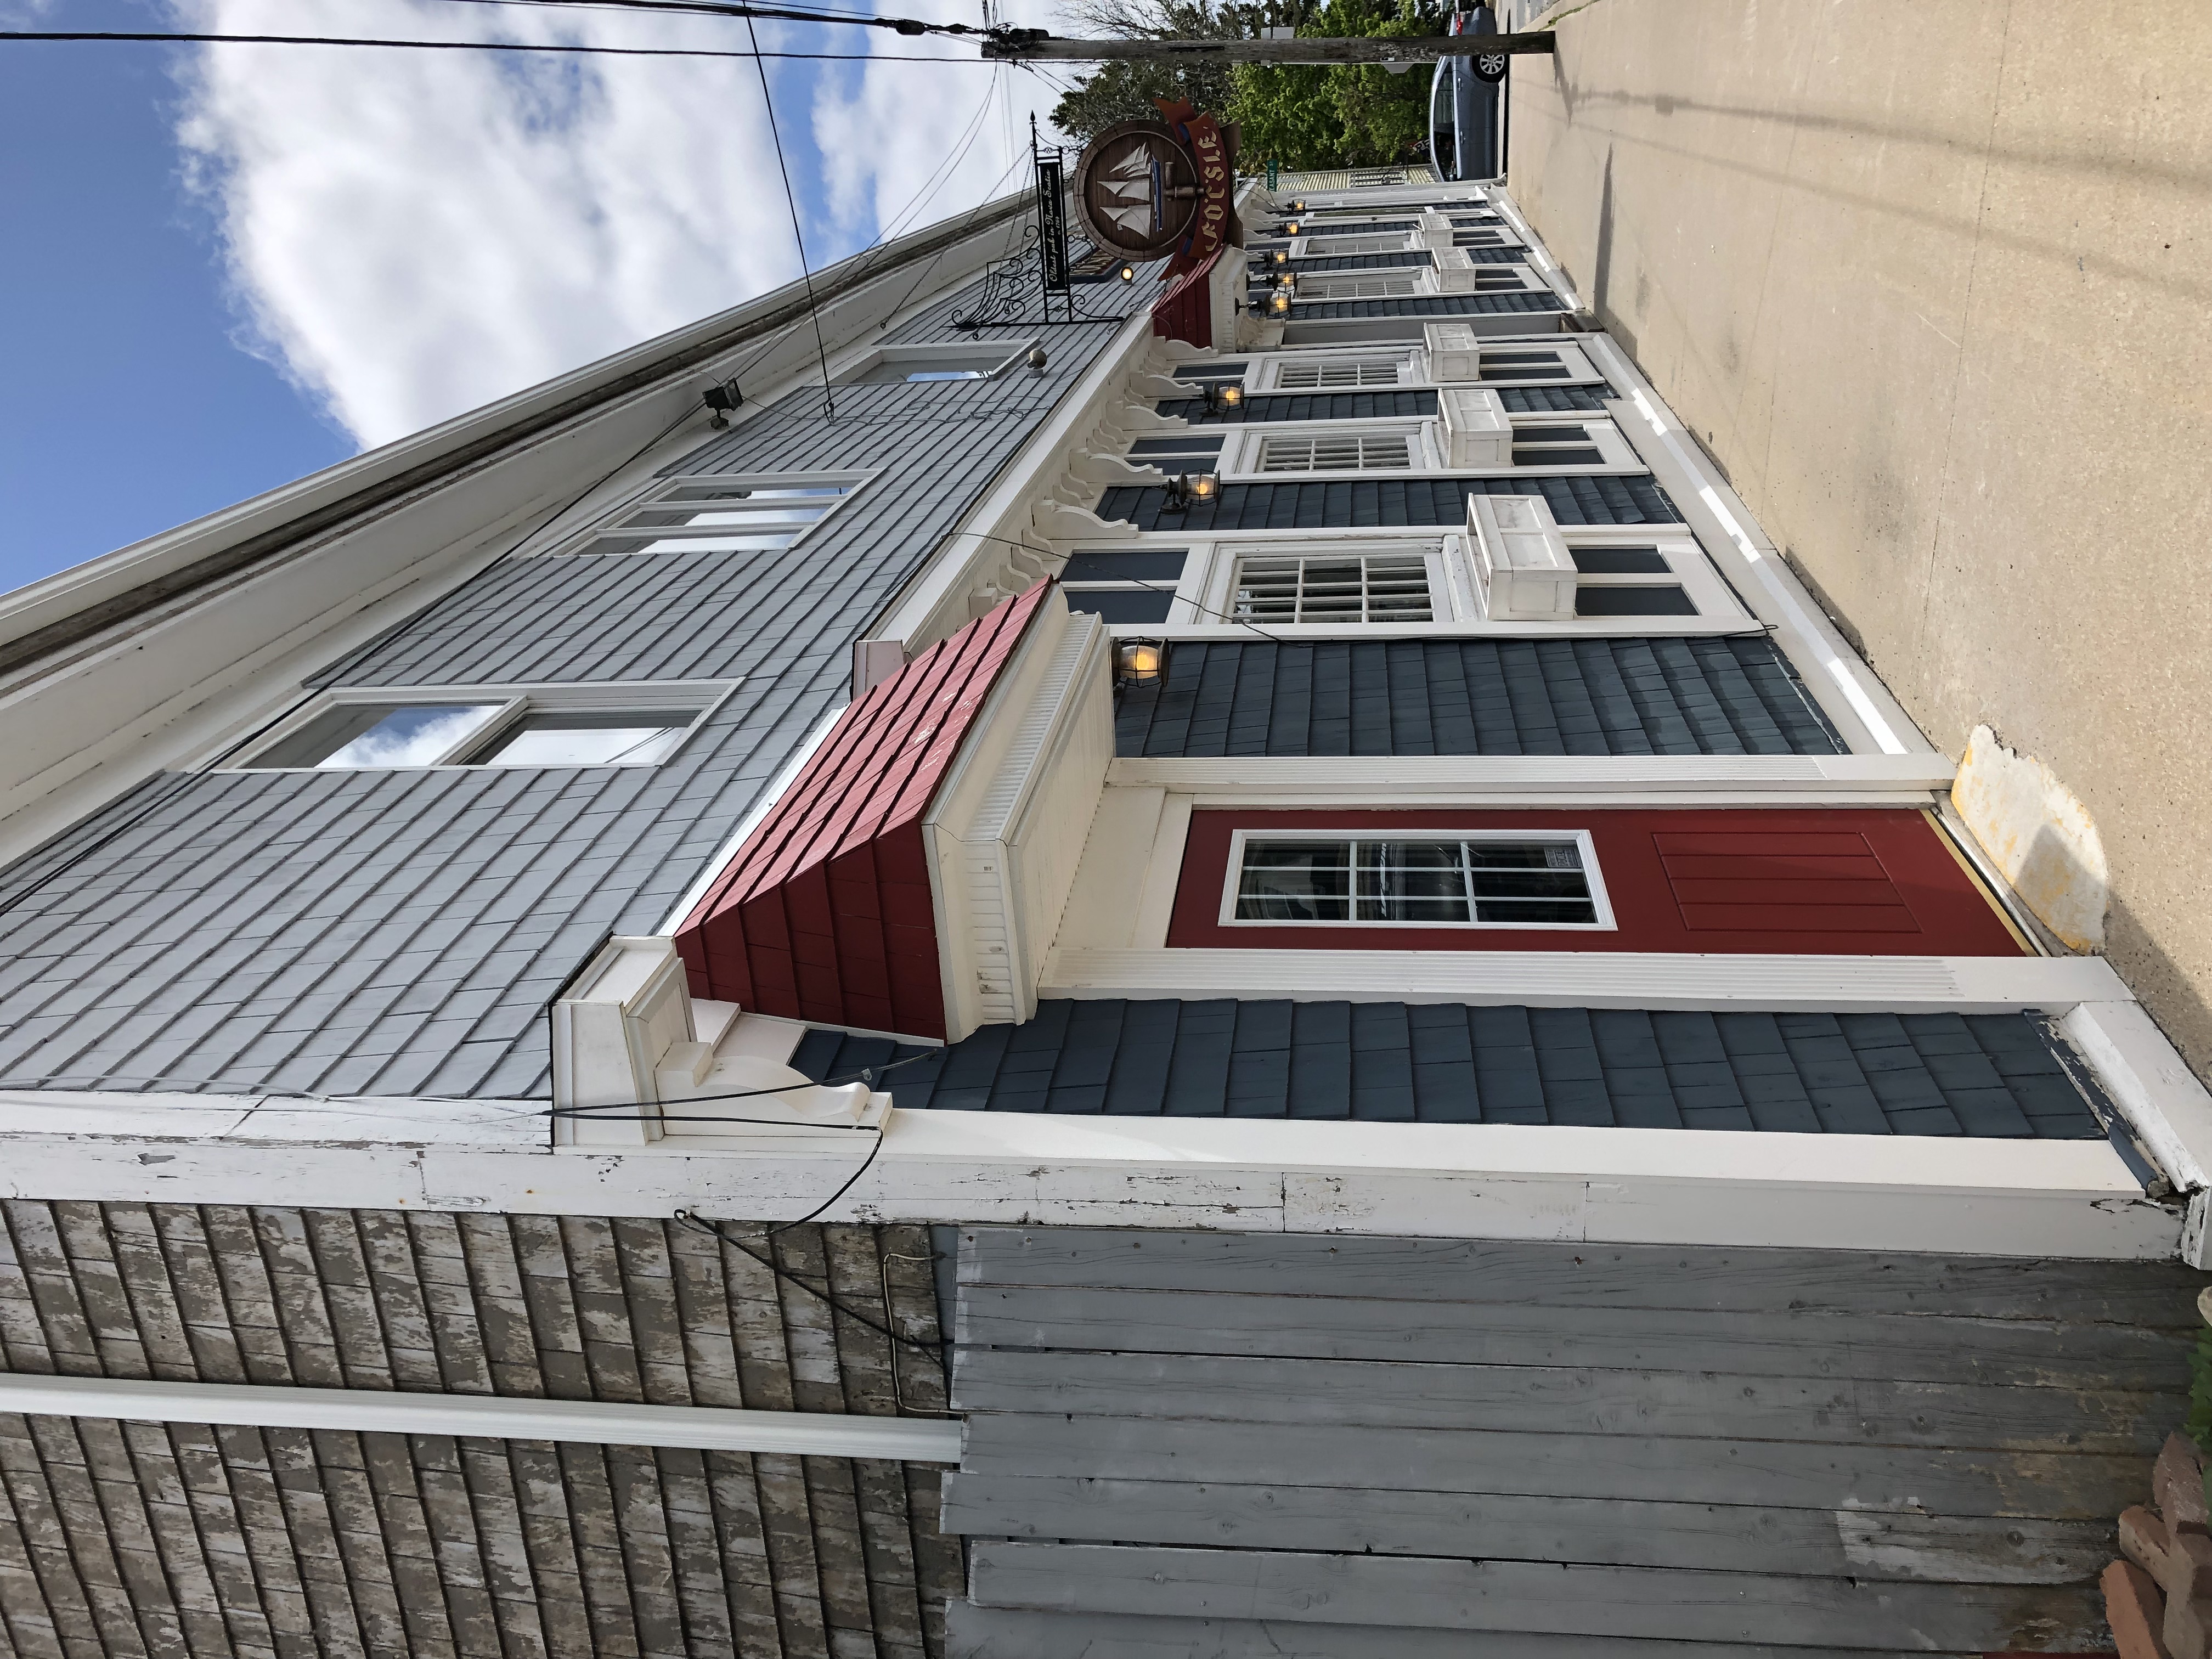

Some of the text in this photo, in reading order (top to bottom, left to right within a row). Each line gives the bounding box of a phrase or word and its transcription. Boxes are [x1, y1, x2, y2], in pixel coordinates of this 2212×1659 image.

[1043, 169, 1058, 282] Oldest pub in Nova Scotia
